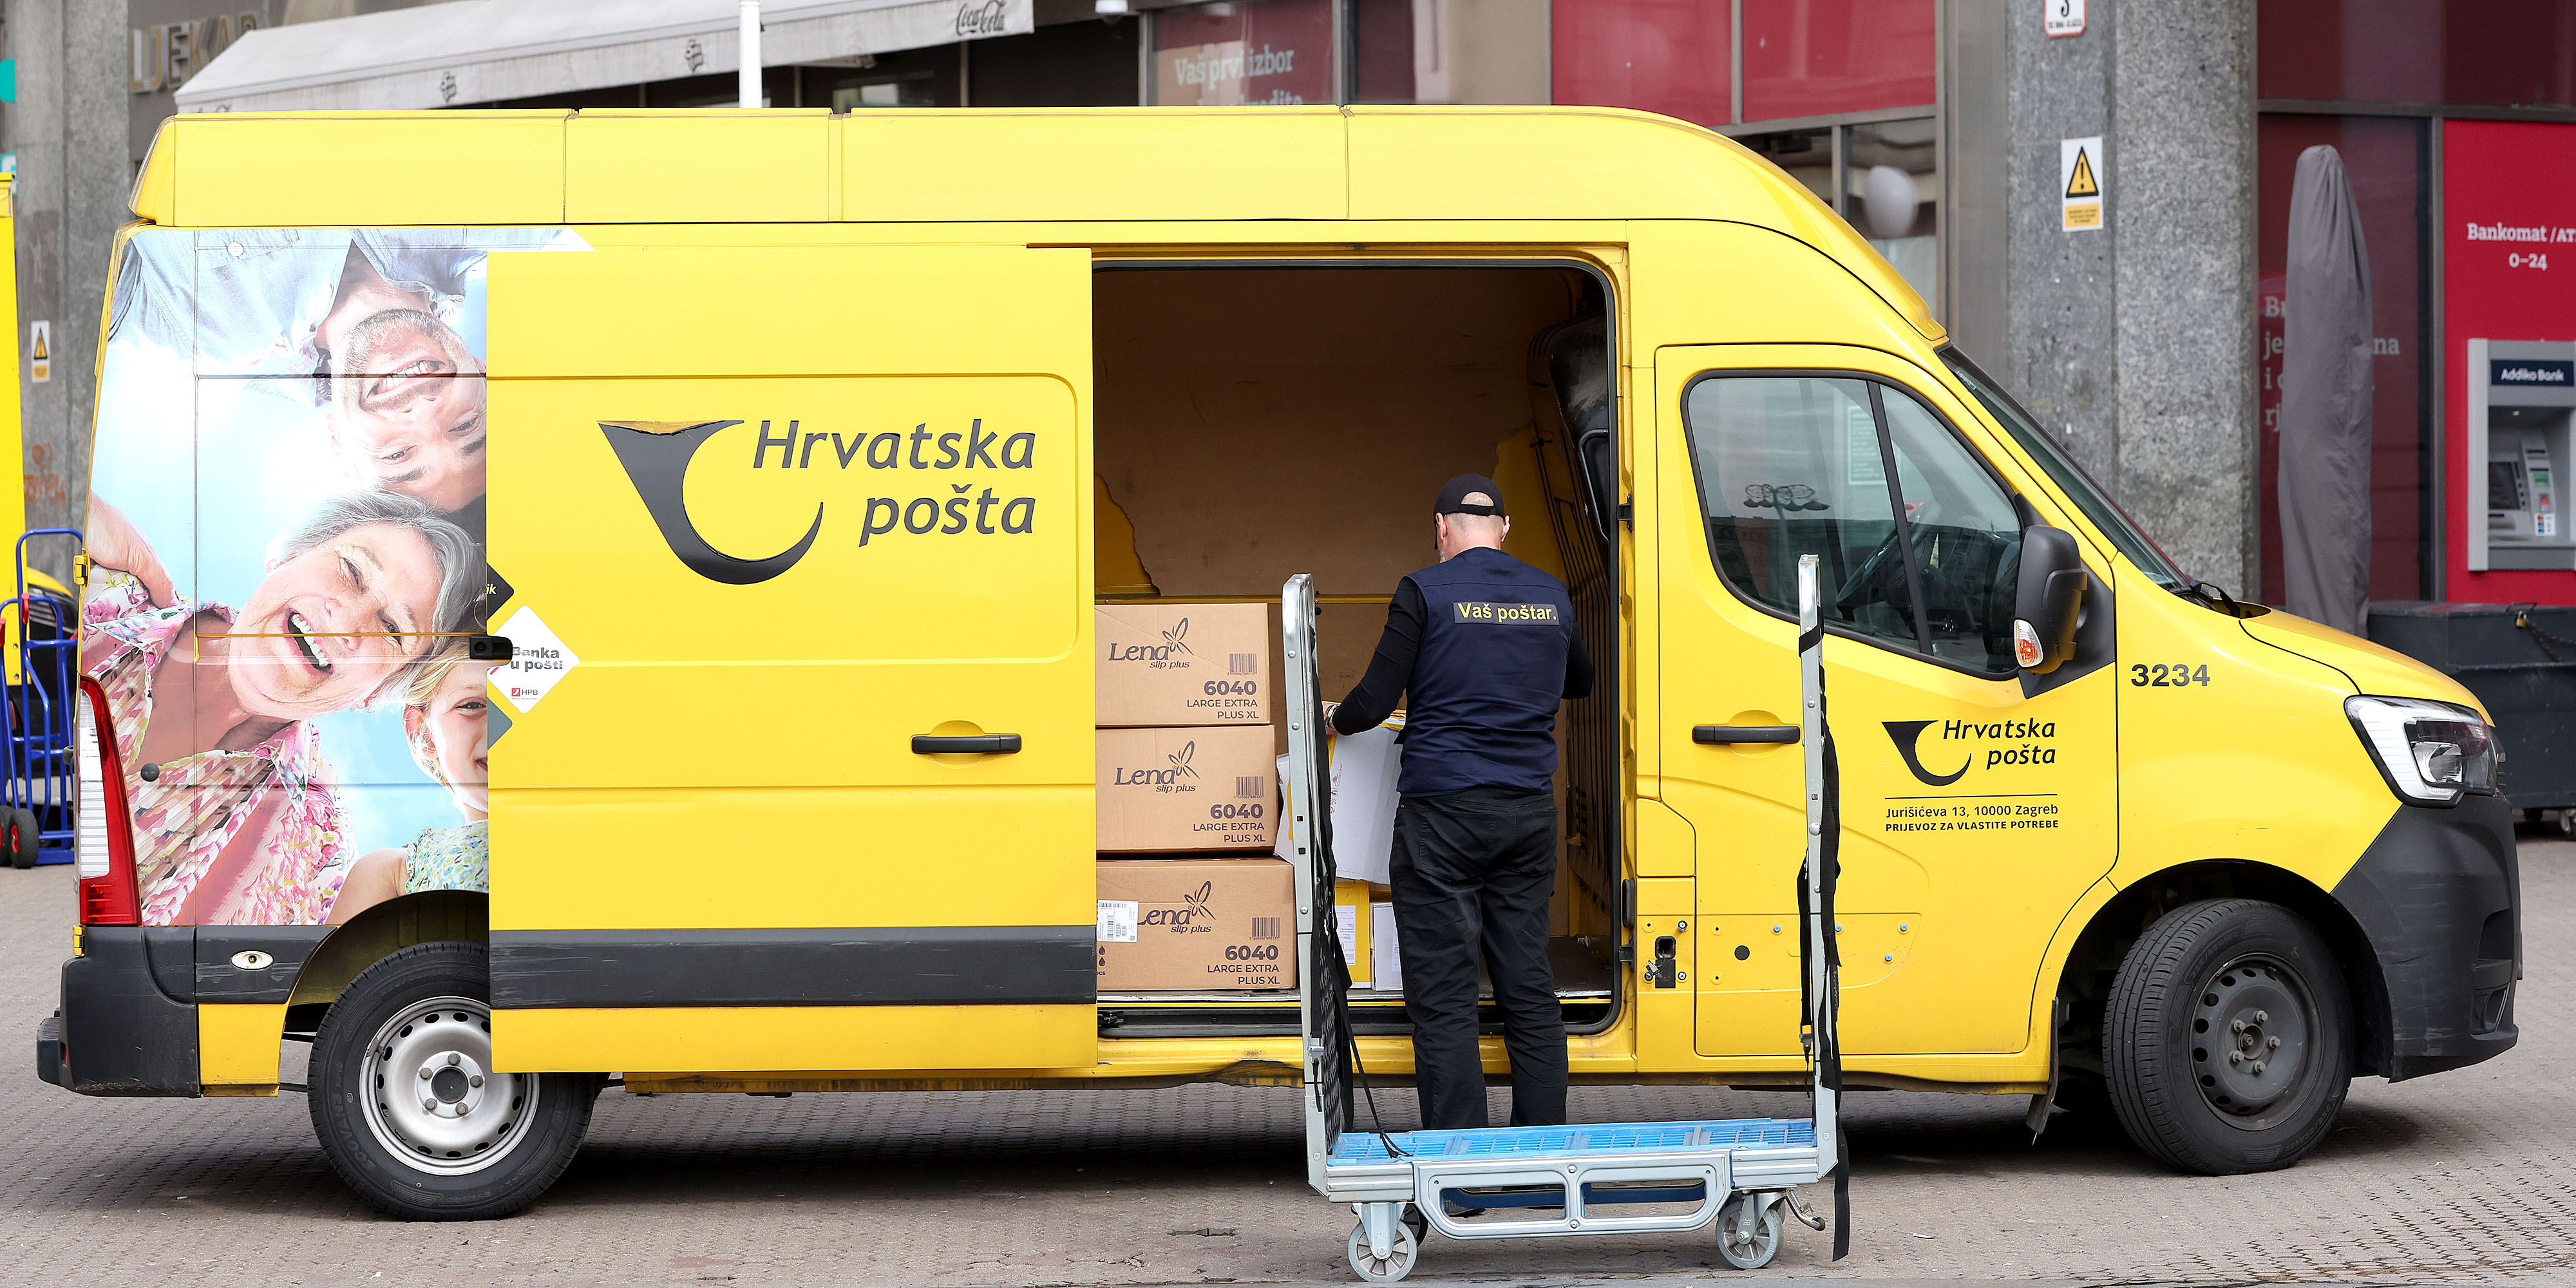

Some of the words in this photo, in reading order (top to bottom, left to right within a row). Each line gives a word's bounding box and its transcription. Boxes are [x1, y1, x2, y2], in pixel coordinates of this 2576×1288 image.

[1174, 54, 1206, 85] Vaš
[1209, 48, 1245, 90] prvi
[1249, 44, 1294, 77] izbor
[2467, 222, 2548, 242] Bankomat
[2501, 368, 2537, 381] Addiko
[2537, 368, 2564, 381] Bank
[753, 419, 1036, 469] Hrvatska
[858, 484, 1036, 547] pošta
[1457, 603, 1492, 619] Vaš
[1497, 604, 1557, 623] poštar.
[513, 647, 560, 658] Banka
[1108, 643, 1170, 661] Lena
[511, 661, 519, 669] u
[525, 660, 563, 672] pošti
[1150, 660, 1167, 670] slip
[1169, 661, 1190, 670] plus
[2131, 664, 2210, 687] 3234
[1204, 680, 1257, 696] 6040
[1944, 717, 2055, 740] Hrvatska
[1987, 744, 2056, 770] pošta
[1114, 767, 1176, 786] Lena
[1155, 784, 1173, 793] slip
[1175, 784, 1197, 793] plus
[1210, 803, 1264, 819] 6040
[1886, 806, 1947, 819] Jurišićeva
[1952, 807, 1969, 818] 13,
[1974, 805, 2011, 816] 10000
[2015, 804, 2058, 817] Zagreb
[1231, 822, 1264, 831] EXTRA
[1886, 823, 1936, 831] PRIJEVOZ
[1956, 821, 2006, 830] VLASTITE
[2011, 820, 2058, 829] POTREBE
[1170, 924, 1188, 934] slip
[1190, 924, 1211, 934] plus
[1225, 945, 1278, 960] 6040
